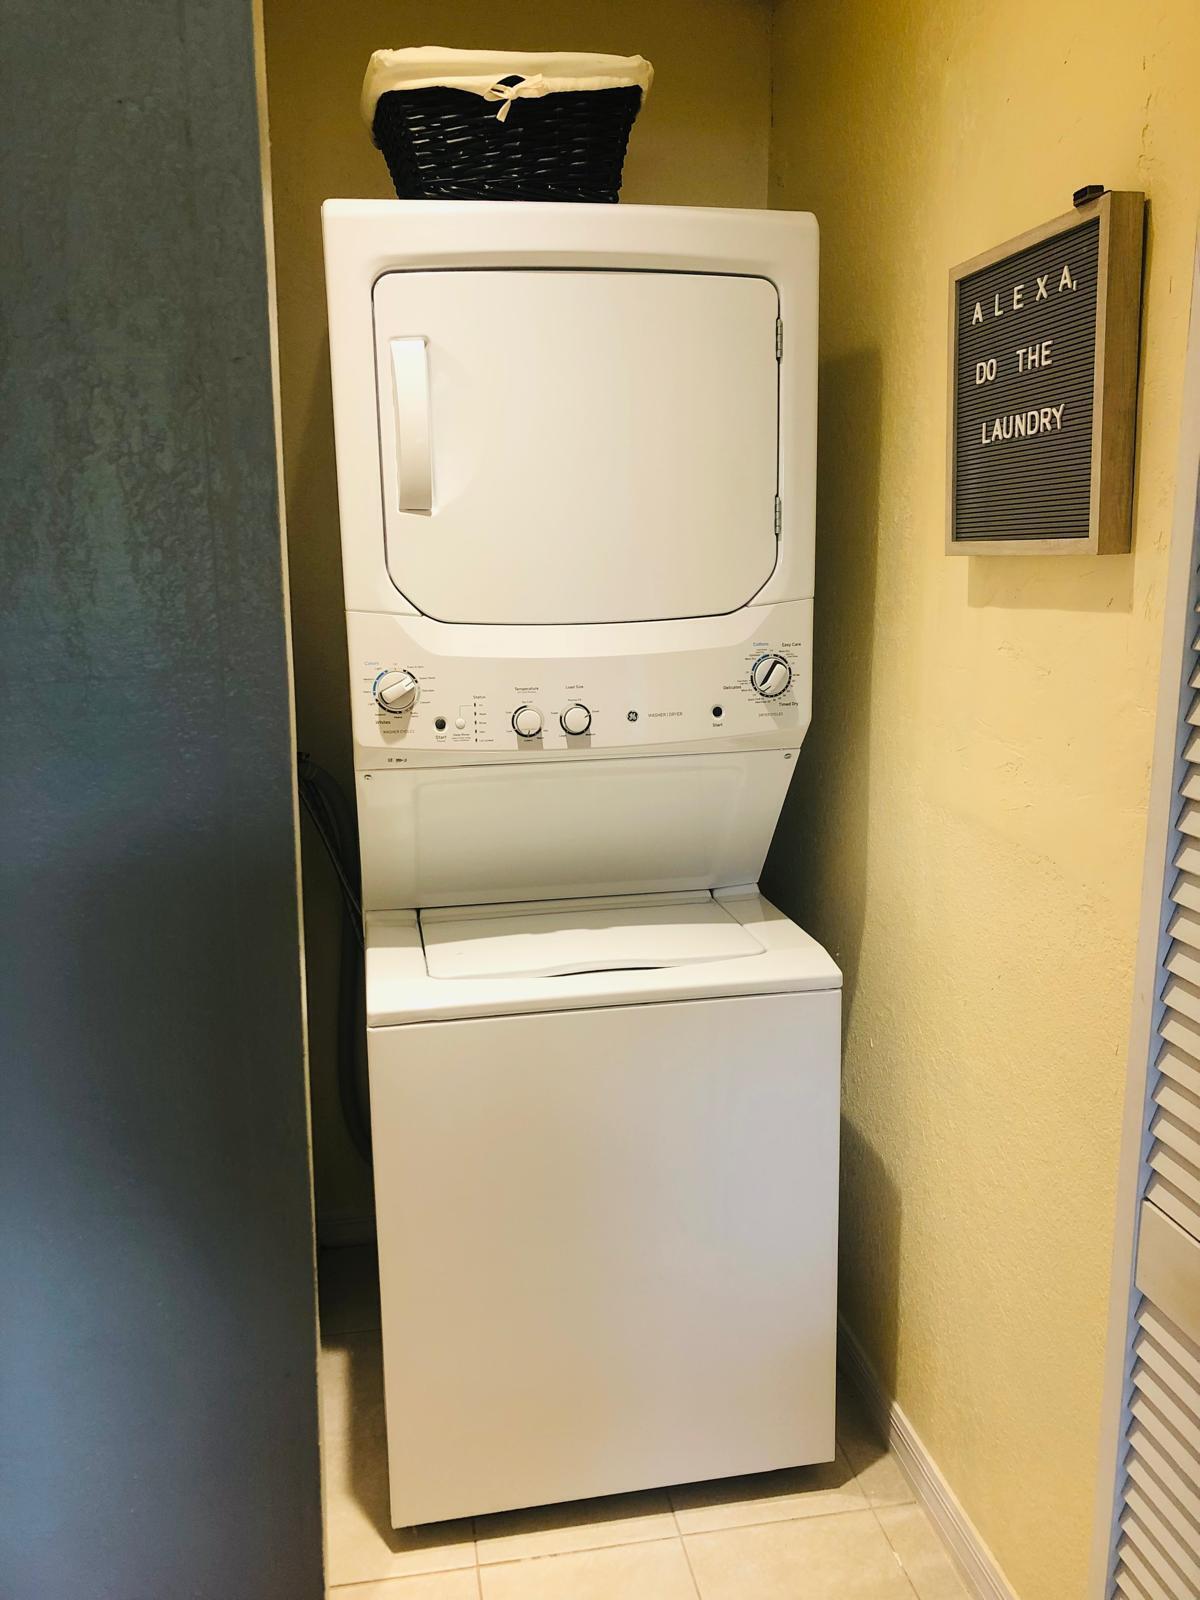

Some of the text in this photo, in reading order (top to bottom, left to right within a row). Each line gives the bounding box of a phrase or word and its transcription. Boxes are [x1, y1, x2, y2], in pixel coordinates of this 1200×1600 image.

[975, 340, 1054, 385] DO THE
[981, 403, 1065, 444] LAUNDRY
